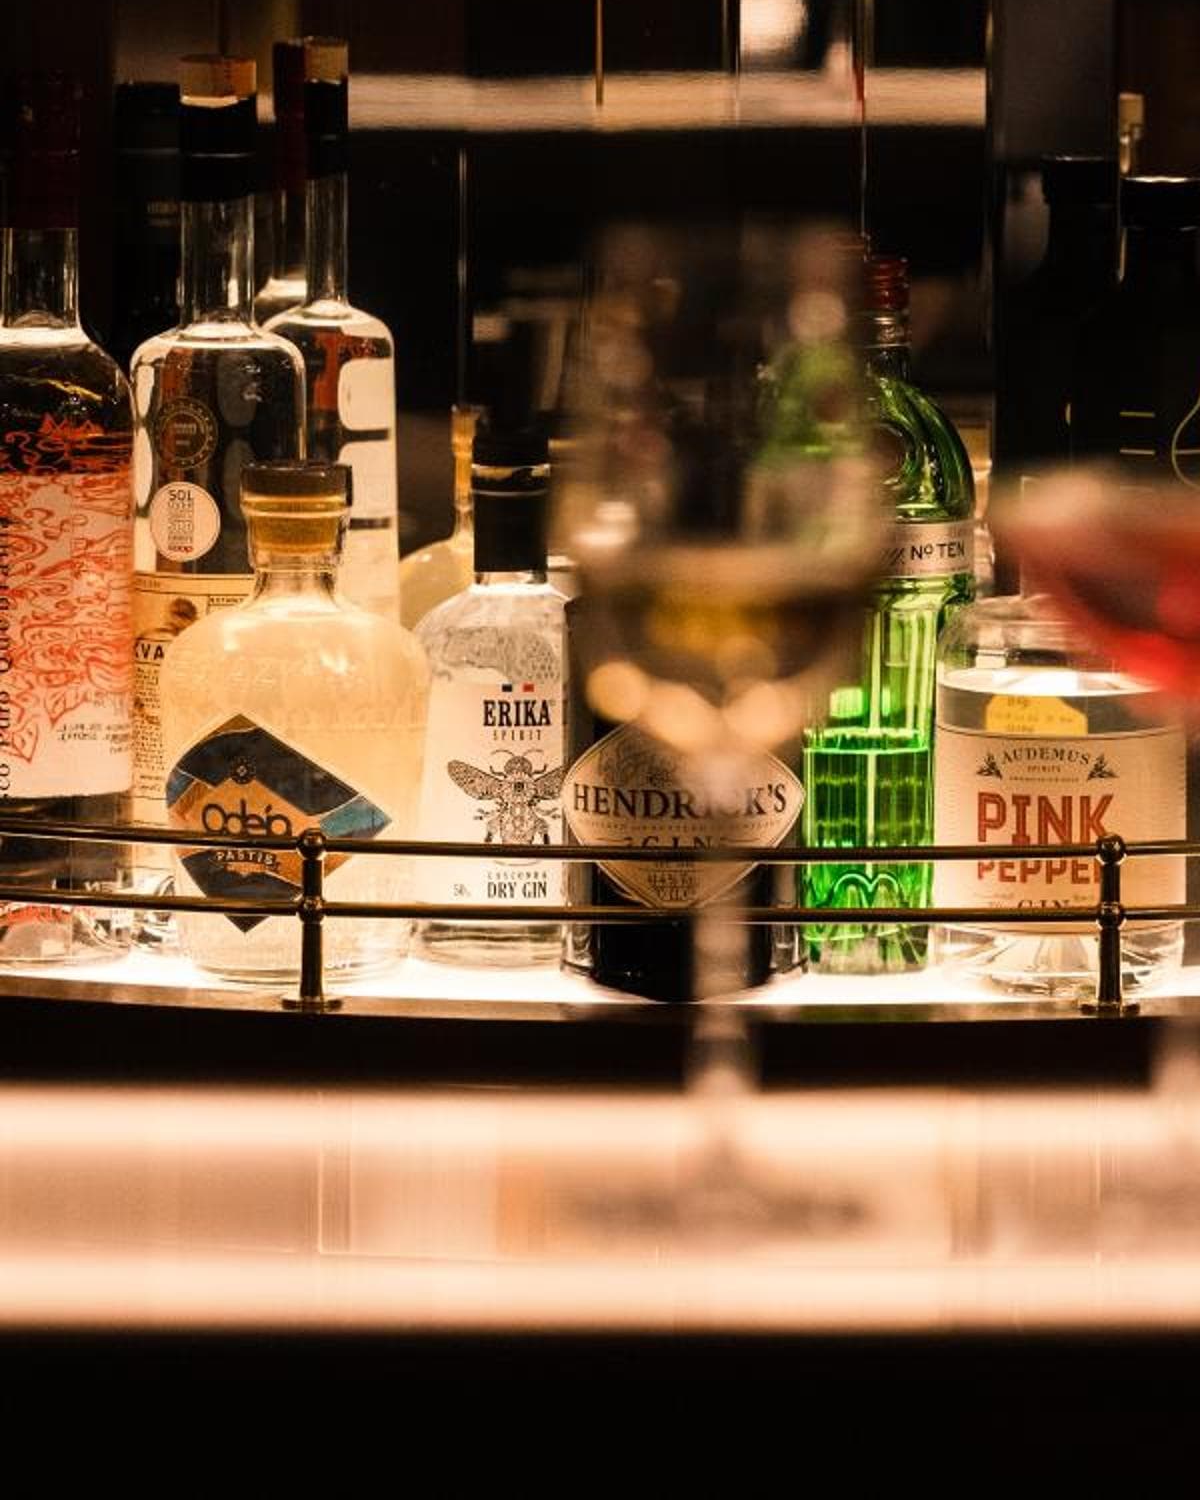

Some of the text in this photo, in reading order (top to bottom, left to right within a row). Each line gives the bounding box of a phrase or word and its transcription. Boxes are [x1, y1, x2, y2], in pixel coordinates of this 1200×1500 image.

[936, 540, 966, 560] TEN
[483, 699, 552, 727] ERIKA
[1001, 746, 1091, 766] AUDEMUS
[976, 791, 1116, 846] PINK
[976, 859, 1101, 885] PEPPE
[487, 881, 517, 899] DRY
[522, 881, 548, 899] GIN
